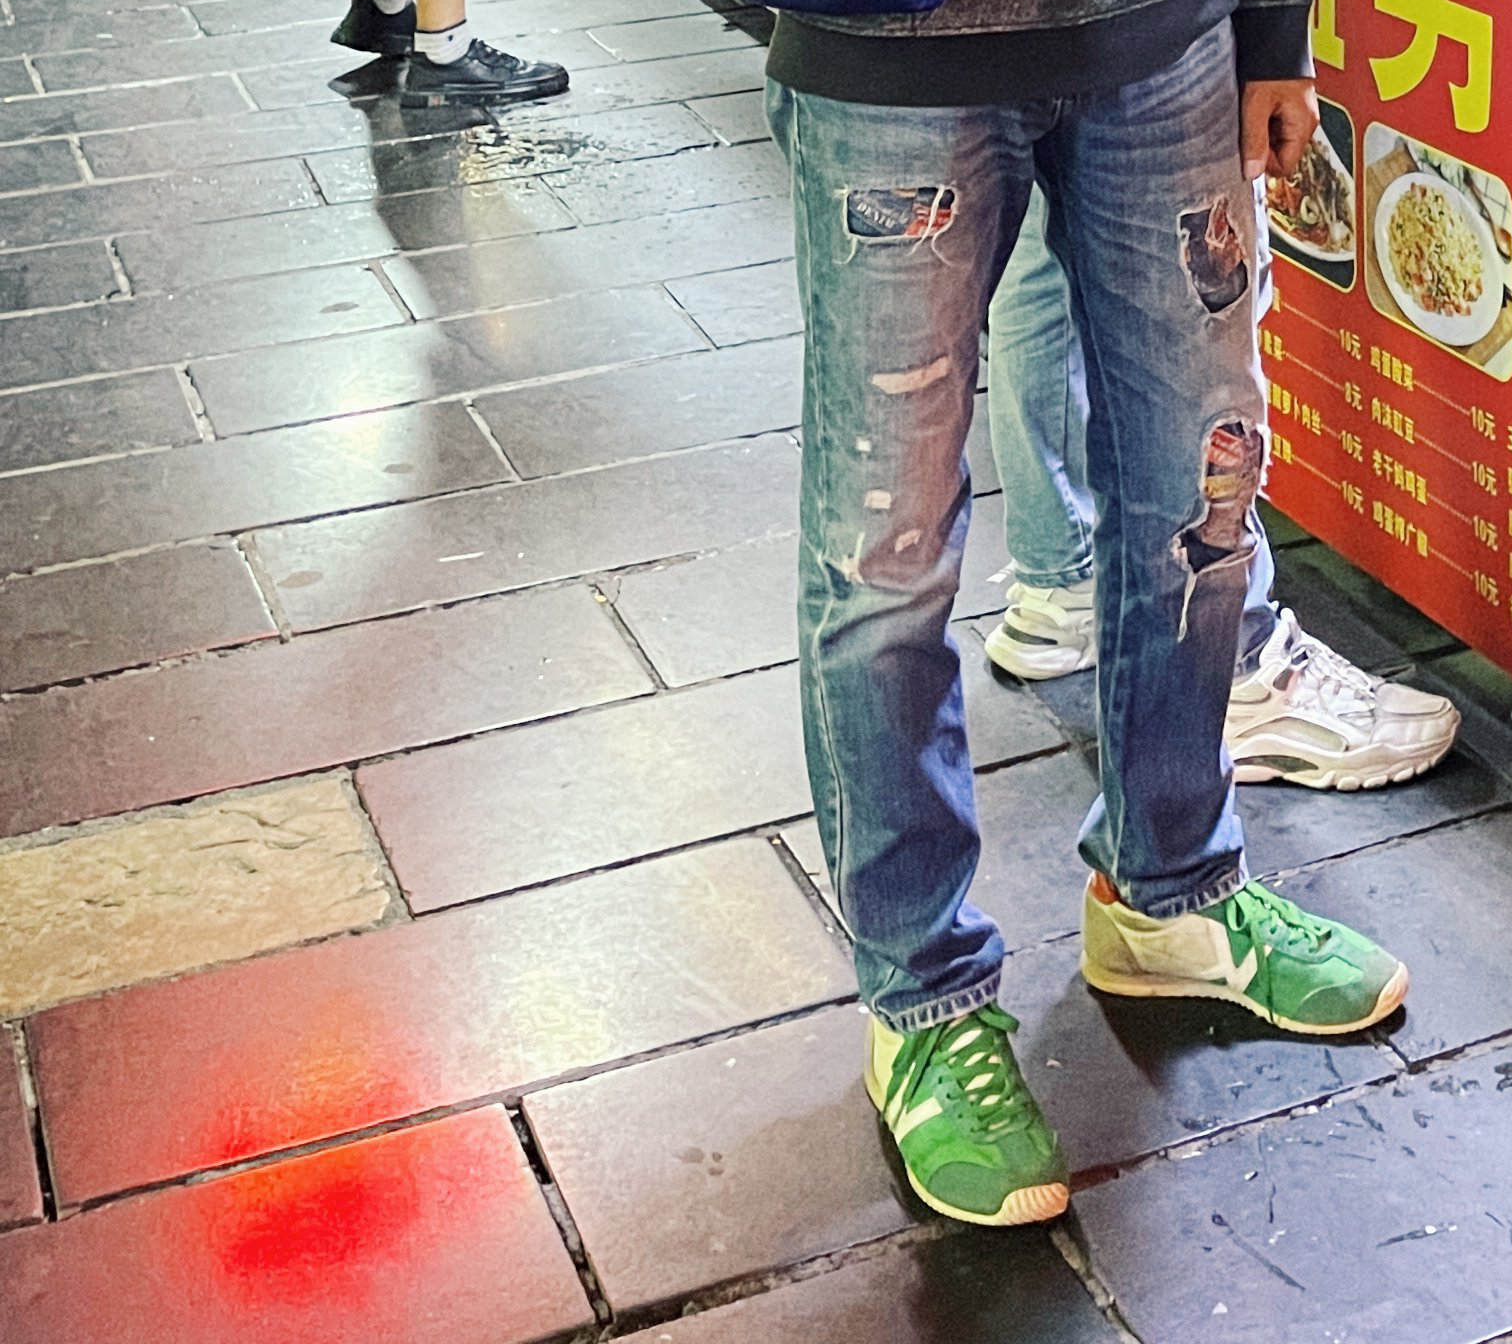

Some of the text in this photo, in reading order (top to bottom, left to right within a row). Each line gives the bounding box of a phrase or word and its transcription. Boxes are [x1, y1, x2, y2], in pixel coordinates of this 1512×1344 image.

[1339, 328, 1362, 361] 10元
[1344, 381, 1363, 411] 8元
[1470, 406, 1496, 441] 10元
[1341, 430, 1363, 463] 10元
[1472, 461, 1497, 496] 10元
[1342, 480, 1365, 514] 10元
[1473, 515, 1498, 552] 10元
[1474, 569, 1500, 607] 10元
